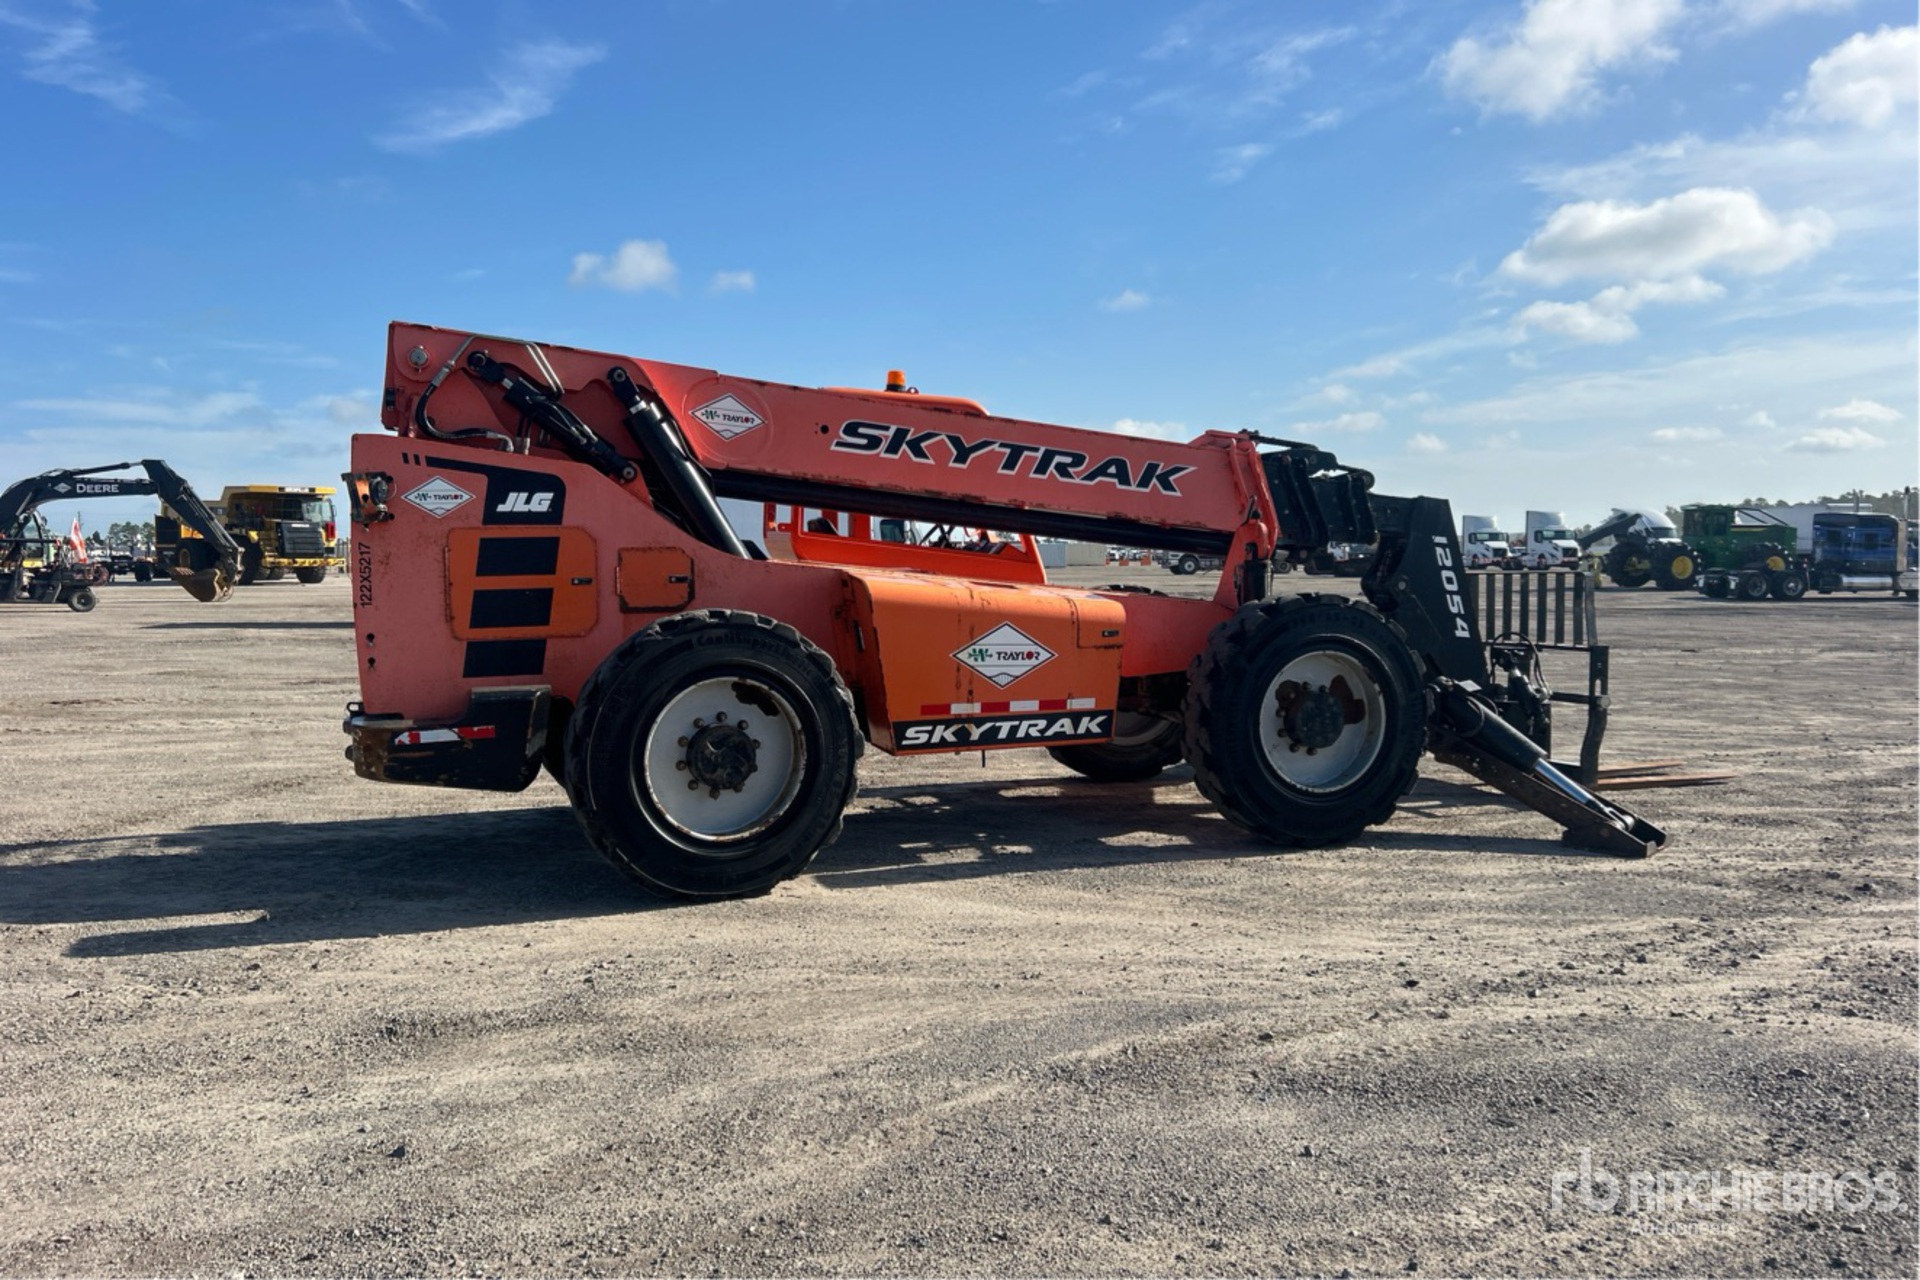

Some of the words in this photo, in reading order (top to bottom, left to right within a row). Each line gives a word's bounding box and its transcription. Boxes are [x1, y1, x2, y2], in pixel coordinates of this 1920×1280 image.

[722, 413, 755, 424] TRAYLOR
[830, 420, 1198, 496] SKYTRAK
[76, 483, 119, 493] DEERE
[496, 492, 554, 512] JLG
[358, 541, 373, 608] 122X5217
[1432, 535, 1470, 638] 12054
[996, 650, 1041, 661] TRAYLOR
[901, 714, 1108, 746] SKYTRAK
